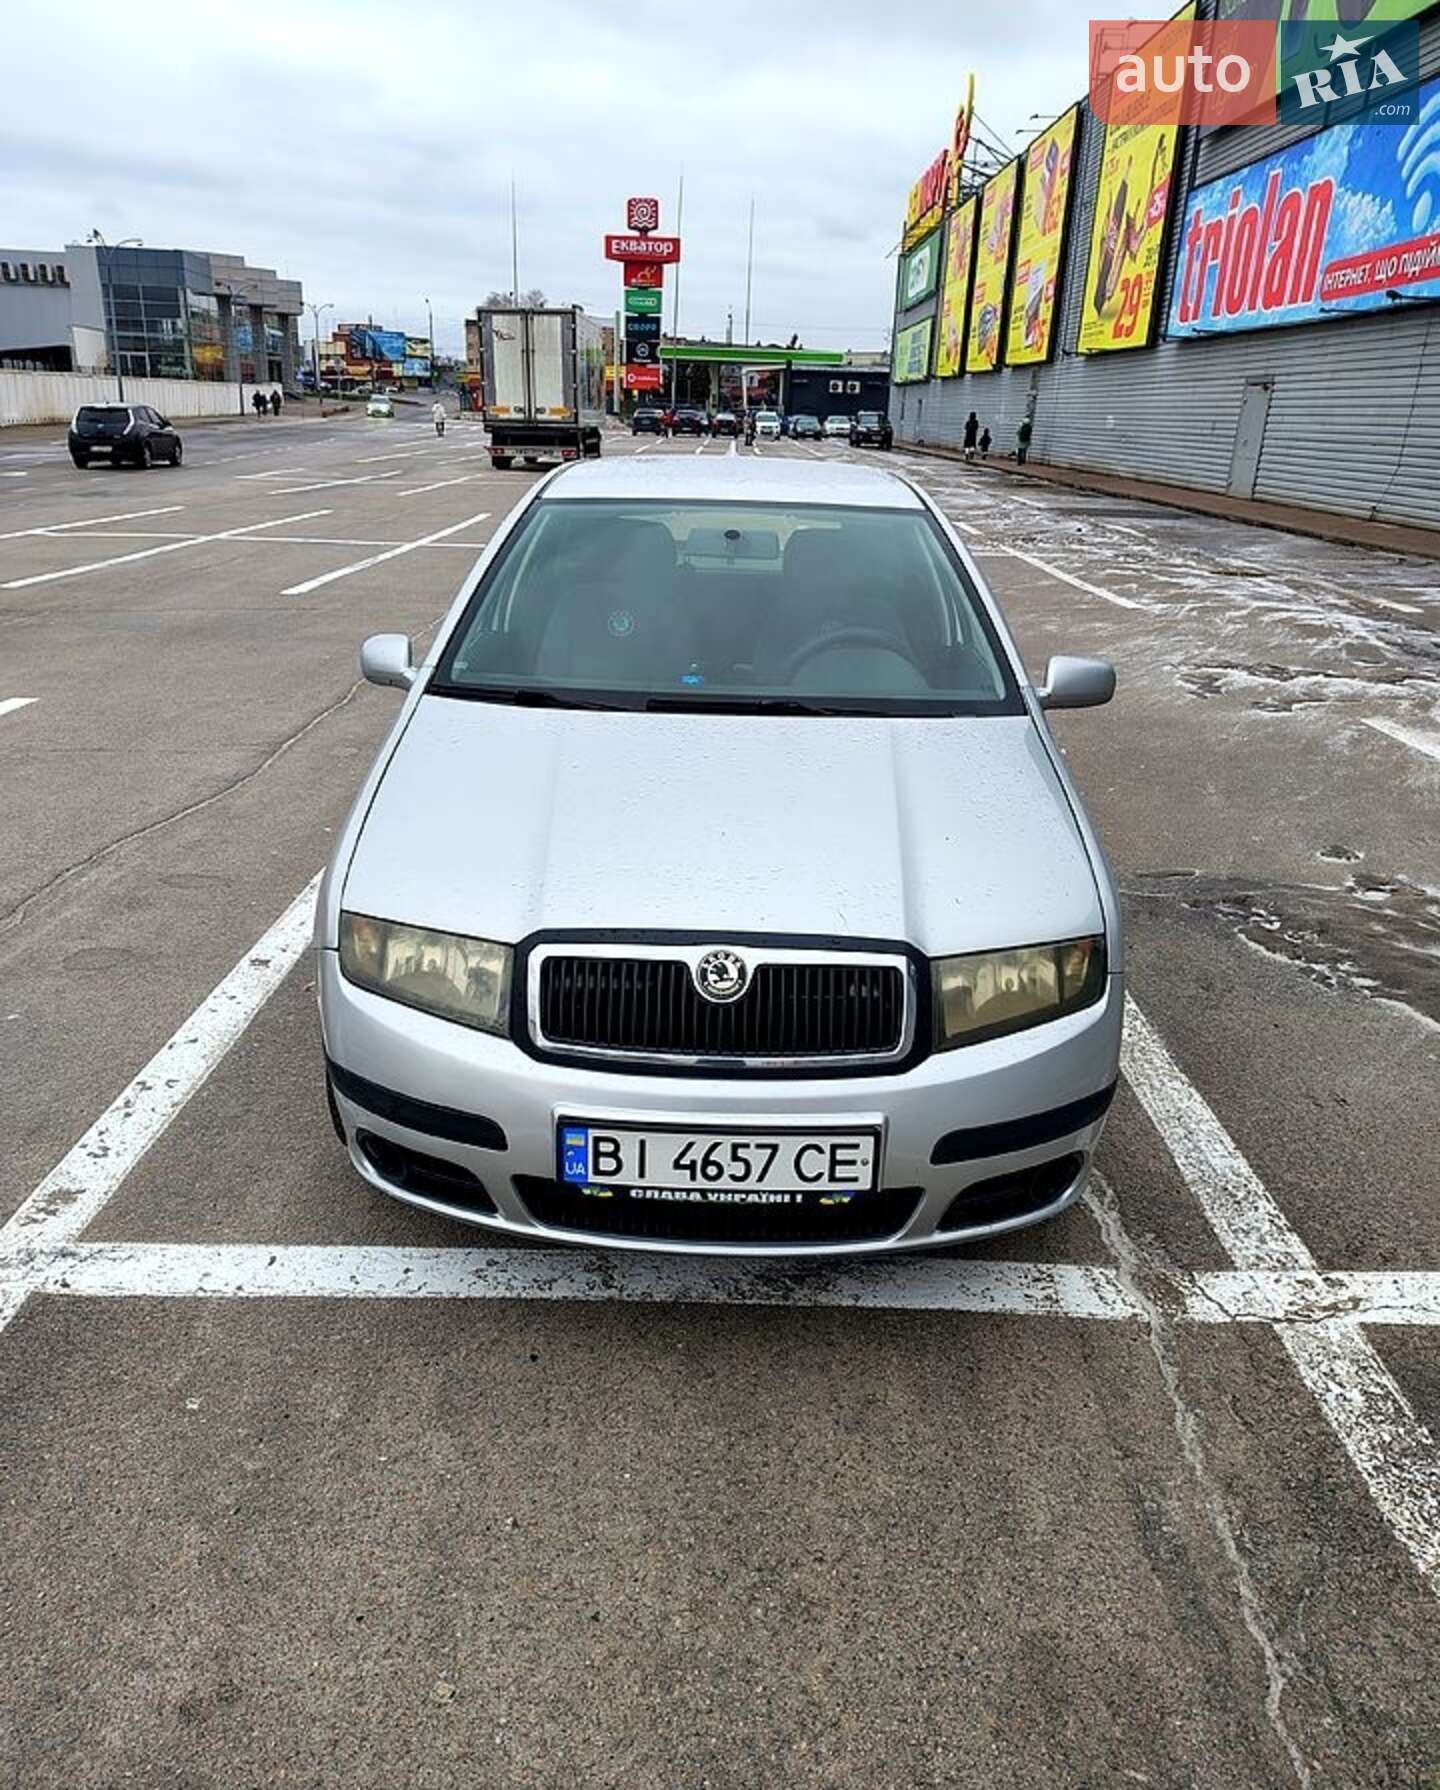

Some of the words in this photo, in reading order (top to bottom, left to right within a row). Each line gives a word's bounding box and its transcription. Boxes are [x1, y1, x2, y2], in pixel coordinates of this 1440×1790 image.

[1178, 170, 1334, 324] triolan
[1111, 272, 1144, 339] 29
[564, 1160, 586, 1176] UA
[672, 1140, 781, 1184] 4657
[793, 1143, 861, 1183] CE
